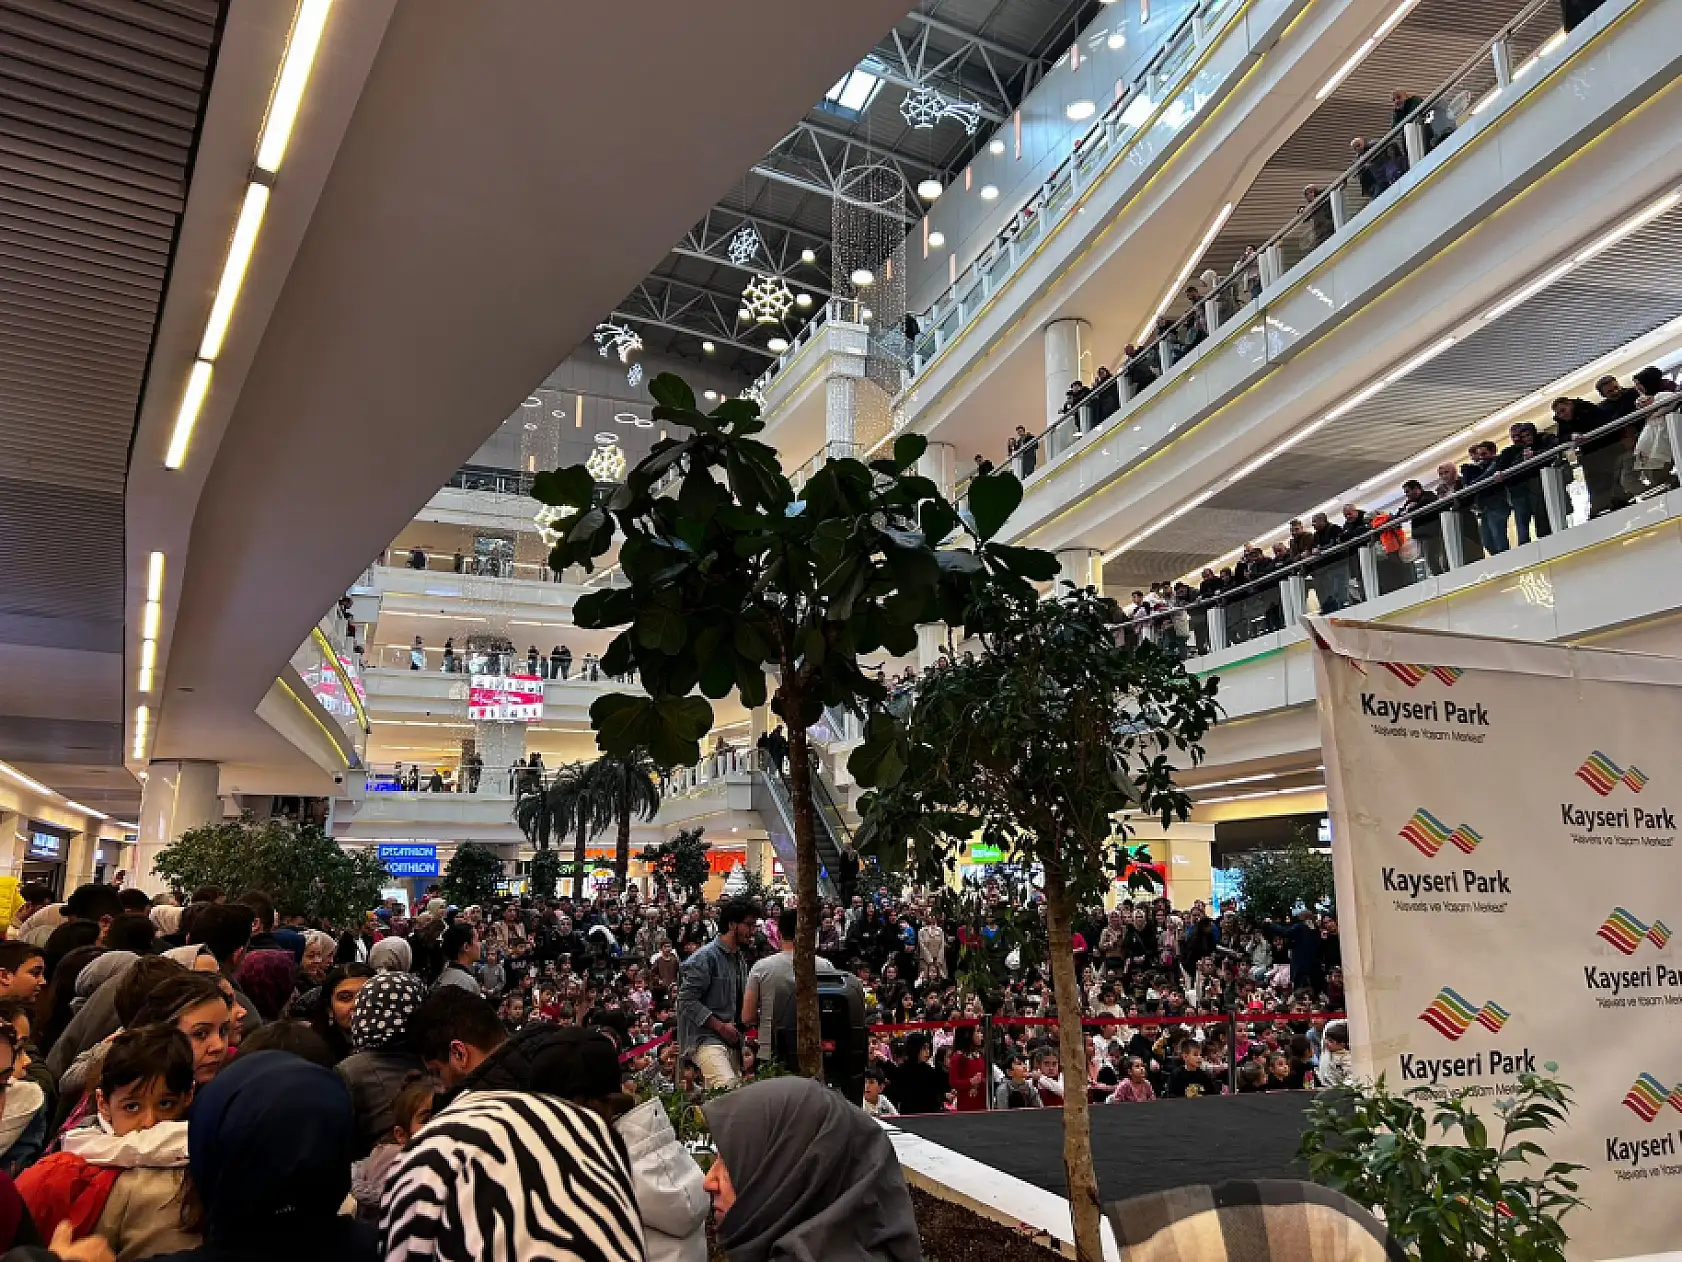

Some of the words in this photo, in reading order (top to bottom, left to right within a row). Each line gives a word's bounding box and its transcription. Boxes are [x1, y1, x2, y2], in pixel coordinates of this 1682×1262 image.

[1361, 693, 1438, 723] Kayseri
[1444, 700, 1489, 725] Park
[1561, 803, 1629, 832] Kayseri
[1634, 807, 1677, 830] Park
[1382, 867, 1458, 898] Kayseri
[1463, 869, 1511, 893] Park
[1584, 966, 1651, 995] Kayseri
[1656, 964, 1682, 986] Par
[1400, 1052, 1481, 1084] Kayseri
[1490, 1048, 1535, 1074] Park
[1606, 1132, 1675, 1167] Kayseri
